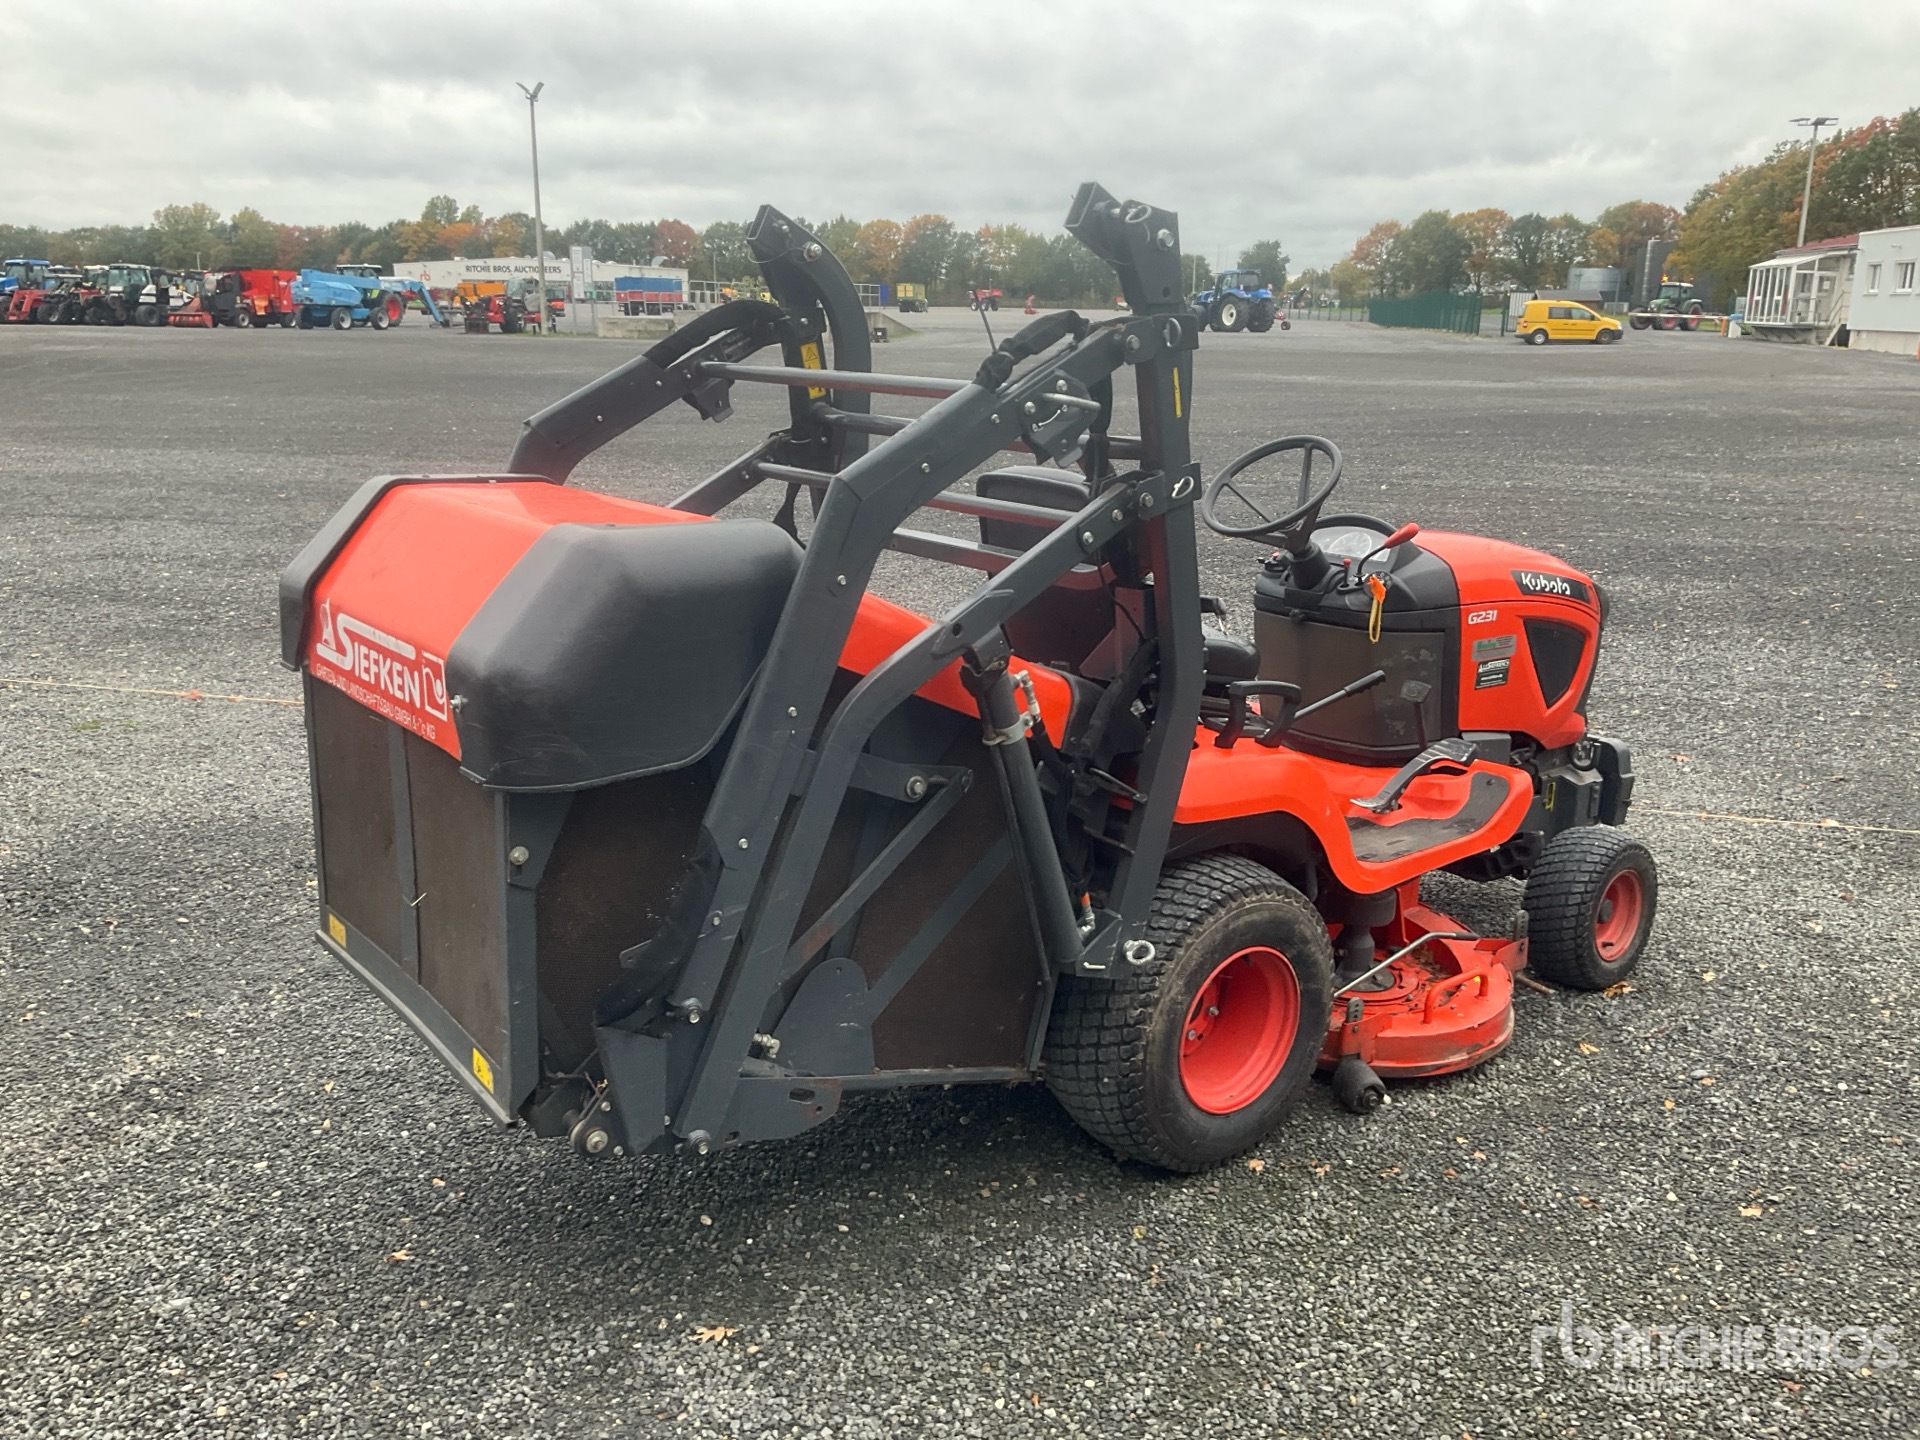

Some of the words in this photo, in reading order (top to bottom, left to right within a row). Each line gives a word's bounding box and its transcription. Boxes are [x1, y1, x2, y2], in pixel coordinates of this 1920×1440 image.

[465, 265, 491, 273] RITCHIE
[493, 265, 512, 273] BROS.
[514, 265, 562, 274] AUCTIOEERS
[1521, 572, 1571, 595] Kubota
[1468, 609, 1498, 625] G231
[316, 613, 420, 709] SIEFKEN
